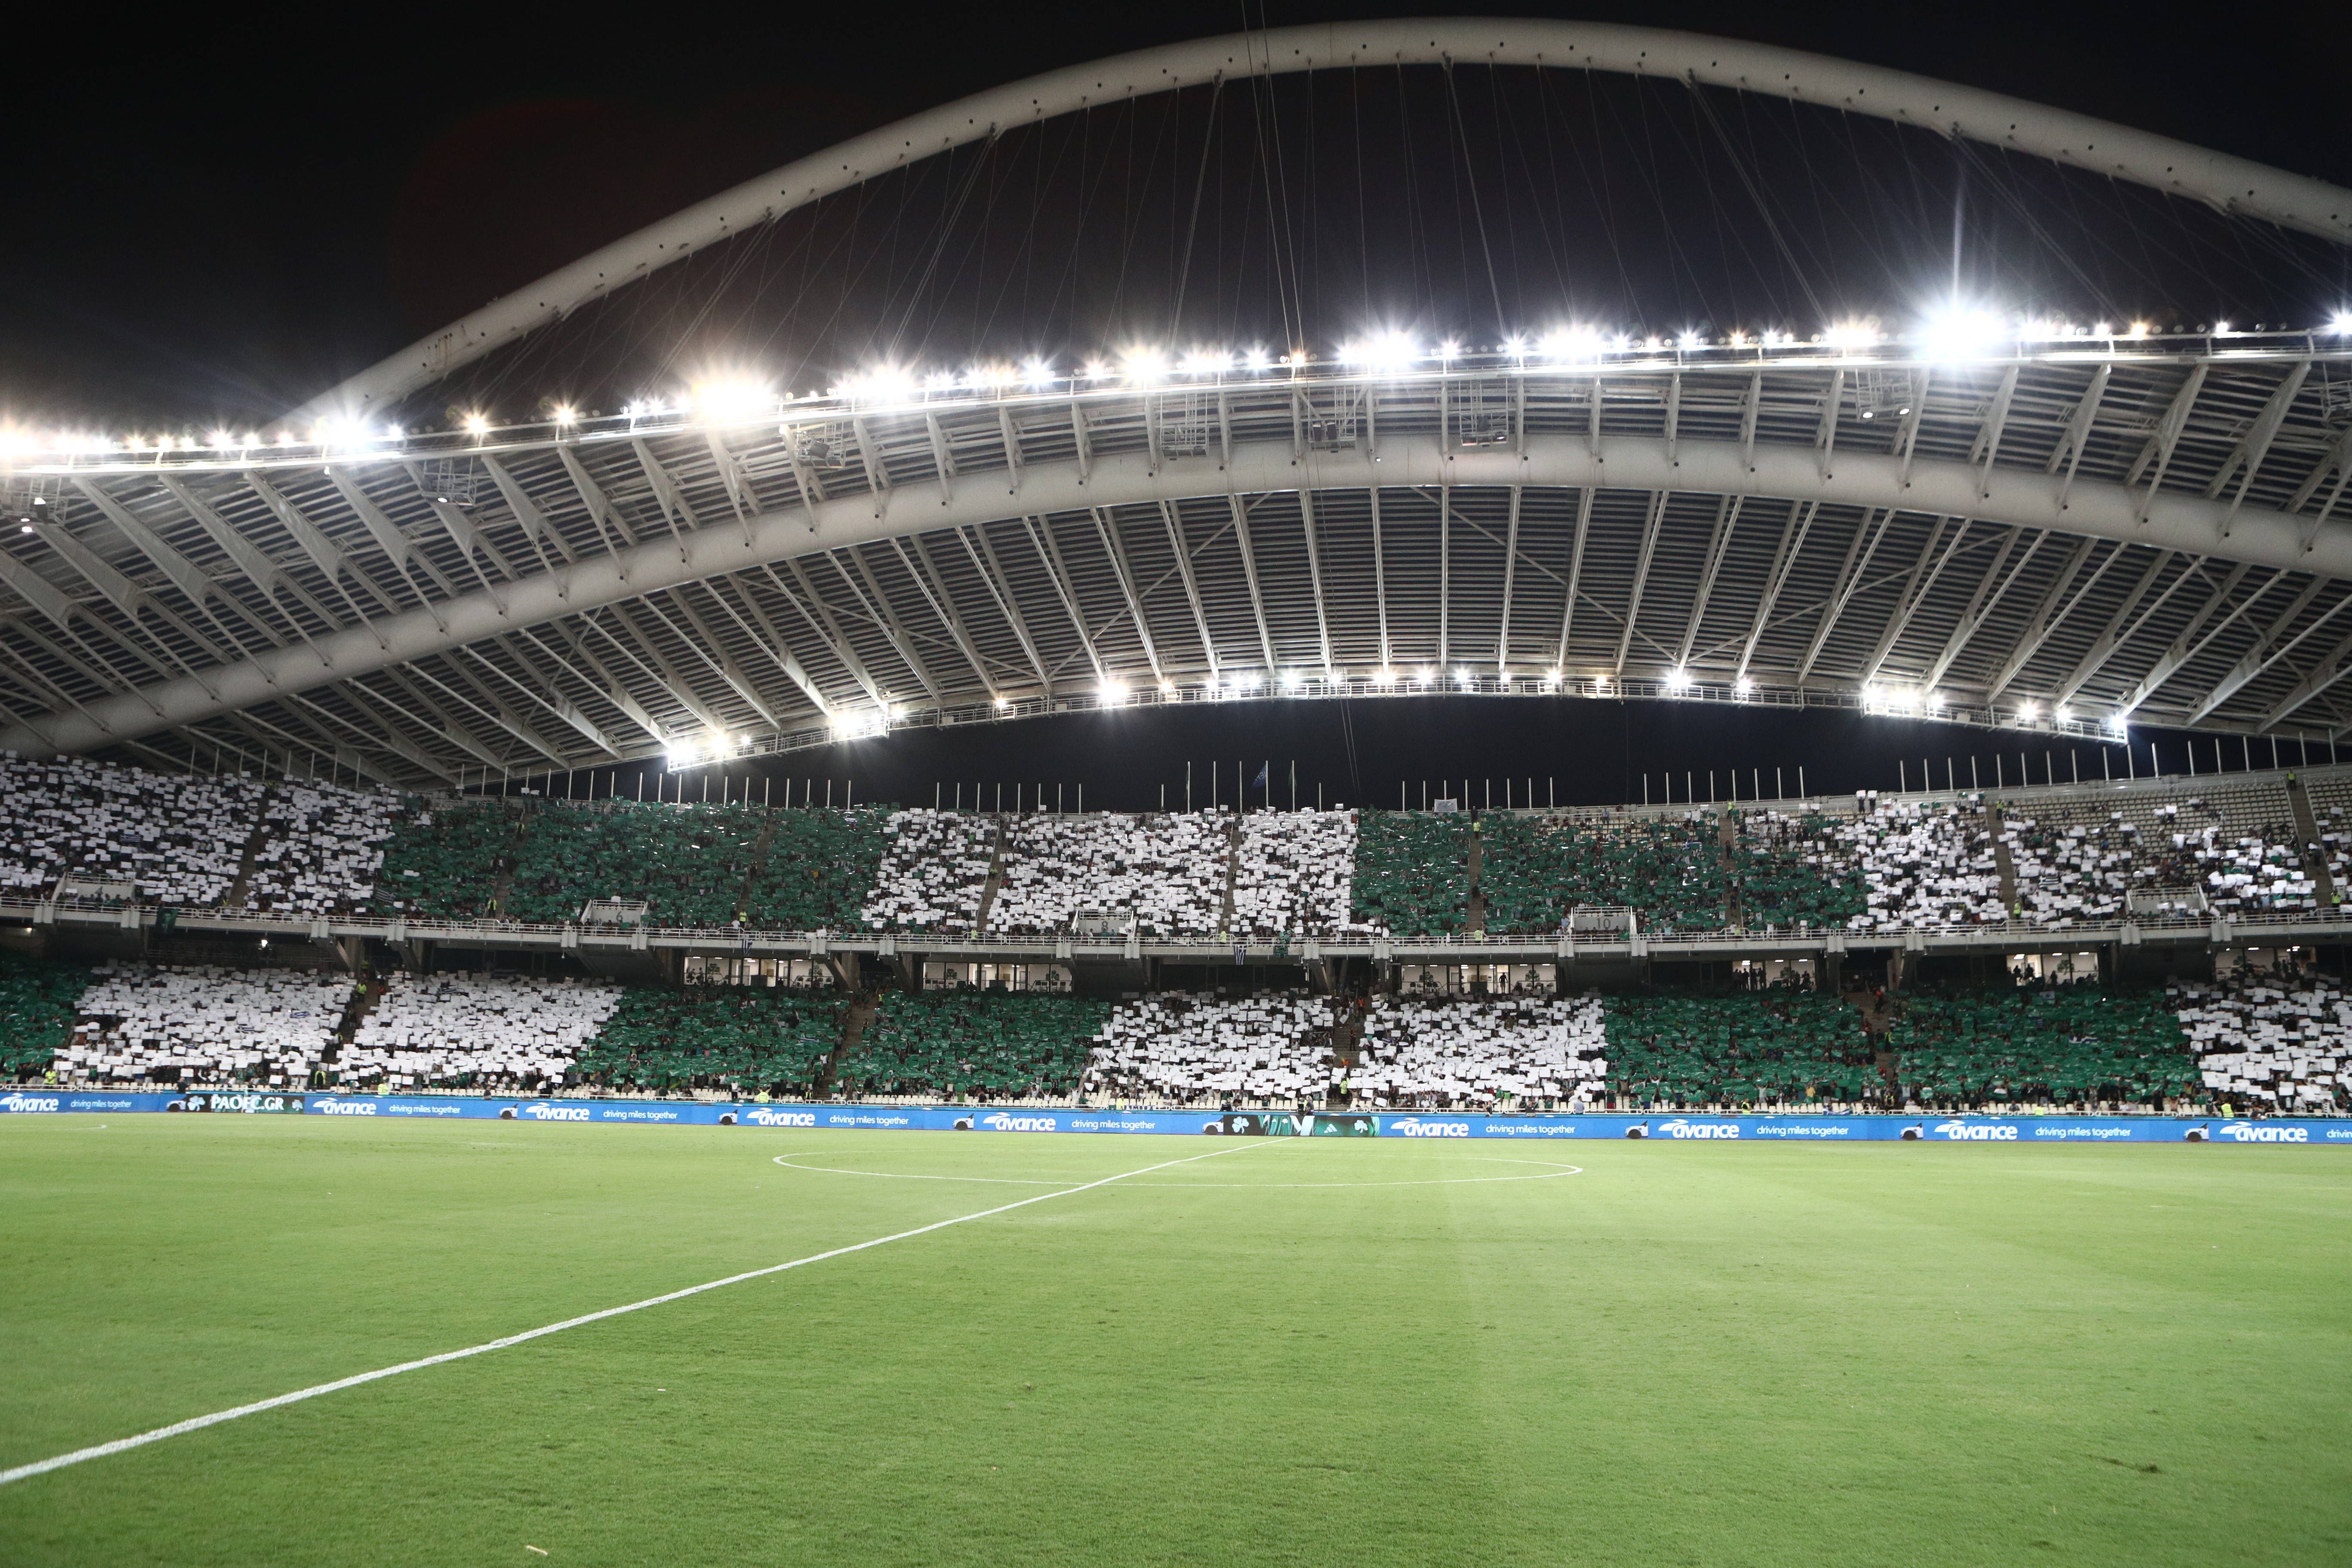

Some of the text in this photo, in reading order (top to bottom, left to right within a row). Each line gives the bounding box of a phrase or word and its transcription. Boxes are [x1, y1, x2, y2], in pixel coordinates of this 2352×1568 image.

[616, 911, 623, 922] 6
[1101, 921, 1108, 931] 8
[1597, 918, 1611, 929] 10
[9, 1099, 59, 1112] avance
[70, 1100, 92, 1109] driving
[107, 1101, 132, 1109] together
[211, 1096, 284, 1110] PAOFC.GR
[323, 1102, 377, 1115] avance
[389, 1105, 413, 1115] driving
[432, 1106, 461, 1115] together
[536, 1108, 590, 1121] avance
[603, 1110, 627, 1120] driving
[647, 1111, 677, 1120] together
[758, 1113, 815, 1126] avance
[830, 1115, 855, 1125] driving
[876, 1116, 909, 1126] together
[995, 1117, 1056, 1131] avance
[1072, 1119, 1155, 1130] driving miles together
[1404, 1122, 1469, 1136] avance
[1485, 1124, 1575, 1135] driving miles together
[1672, 1124, 1740, 1139] avance
[1757, 1125, 1849, 1137] driving miles together
[1948, 1126, 2018, 1140] avance
[2035, 1127, 2131, 1139] driving miles together
[2235, 1127, 2308, 1142] avance
[2327, 1129, 2352, 1138] drivin
